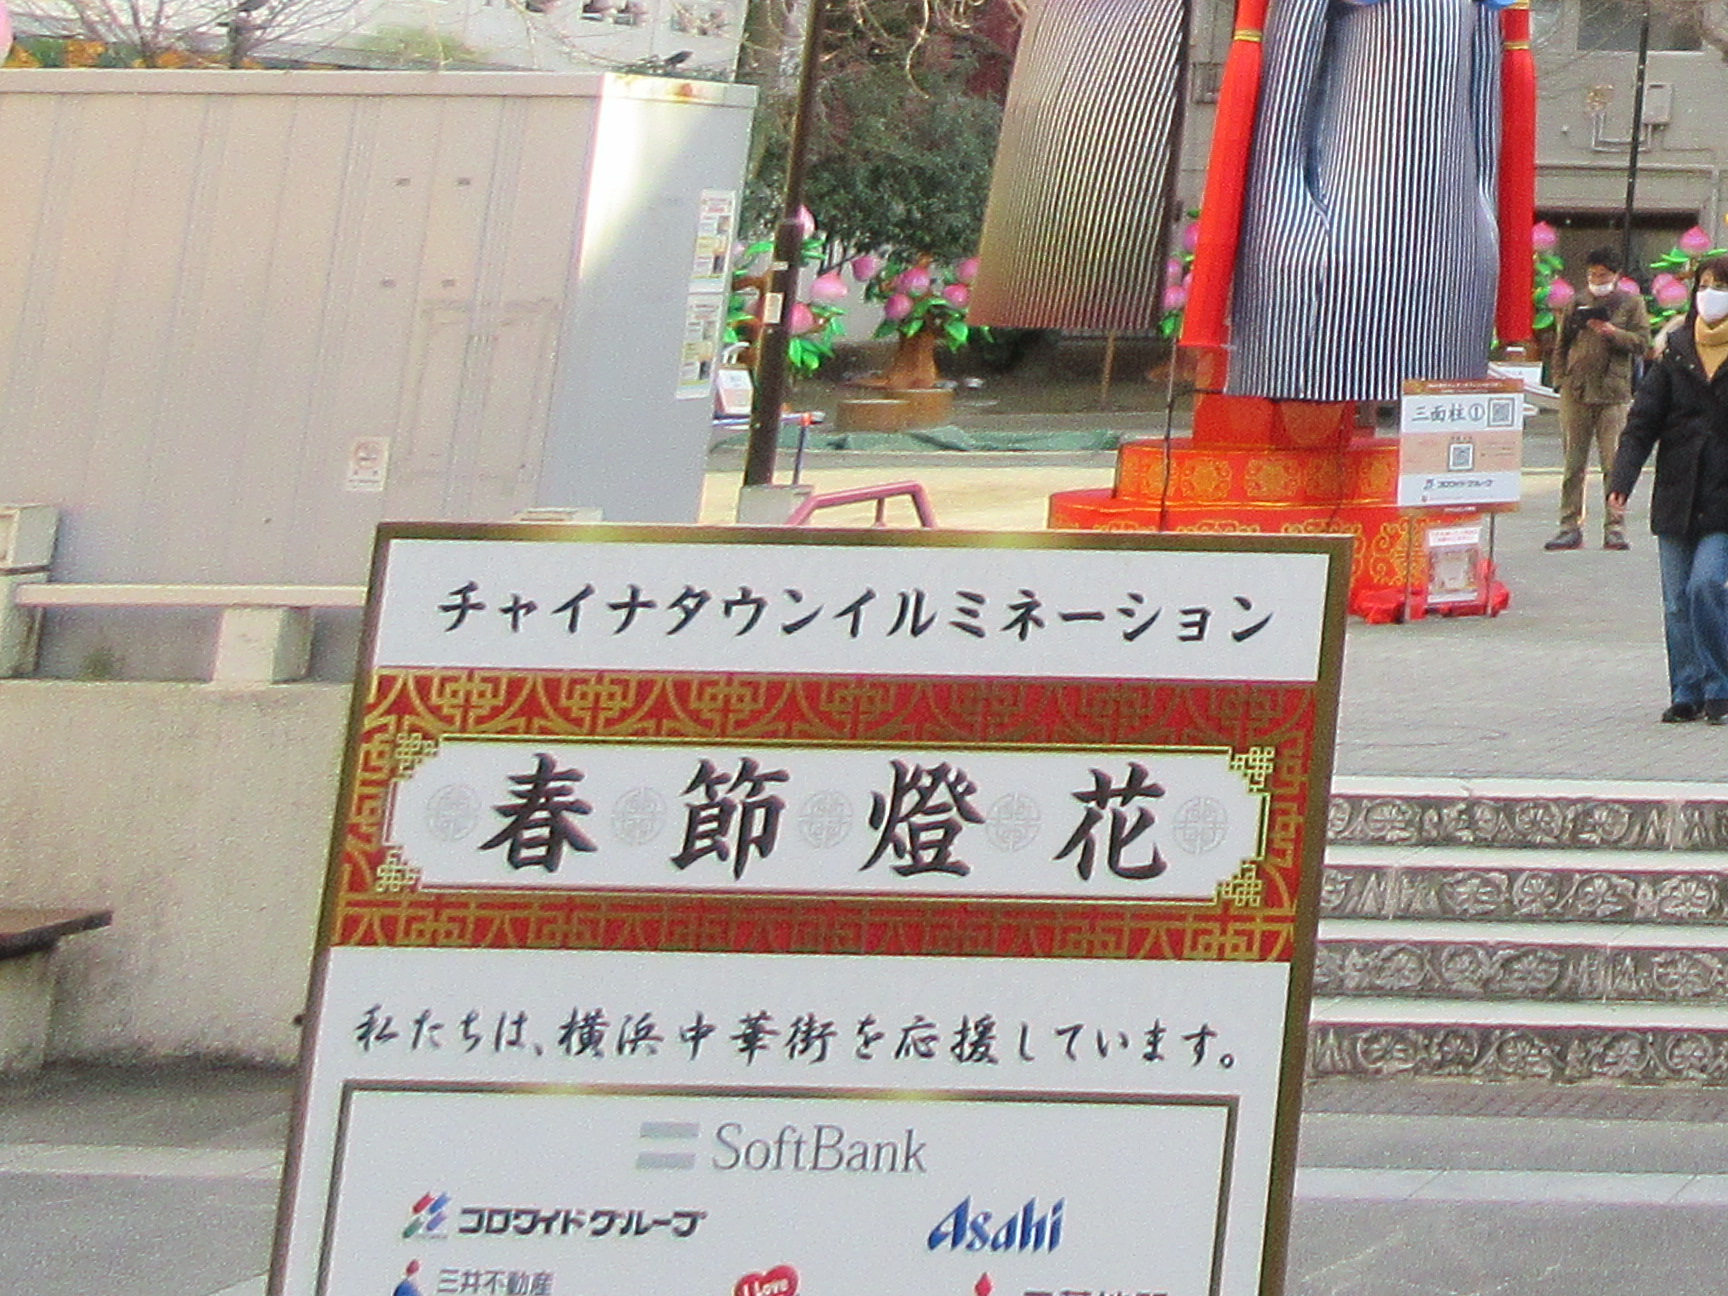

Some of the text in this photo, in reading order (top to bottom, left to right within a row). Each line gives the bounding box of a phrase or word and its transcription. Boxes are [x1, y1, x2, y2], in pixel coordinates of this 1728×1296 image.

[438, 581, 1273, 643] チャイナタウンイルミネーション
[479, 754, 1169, 883] 春節燈花
[355, 1005, 1235, 1069] 私たちは、横浜中華街を応援しています。
[713, 1122, 926, 1173] SoftBank
[458, 1207, 707, 1238] コロワイドグループ
[927, 1196, 1065, 1254] Asahi
[438, 1269, 552, 1296] 三井不動産
